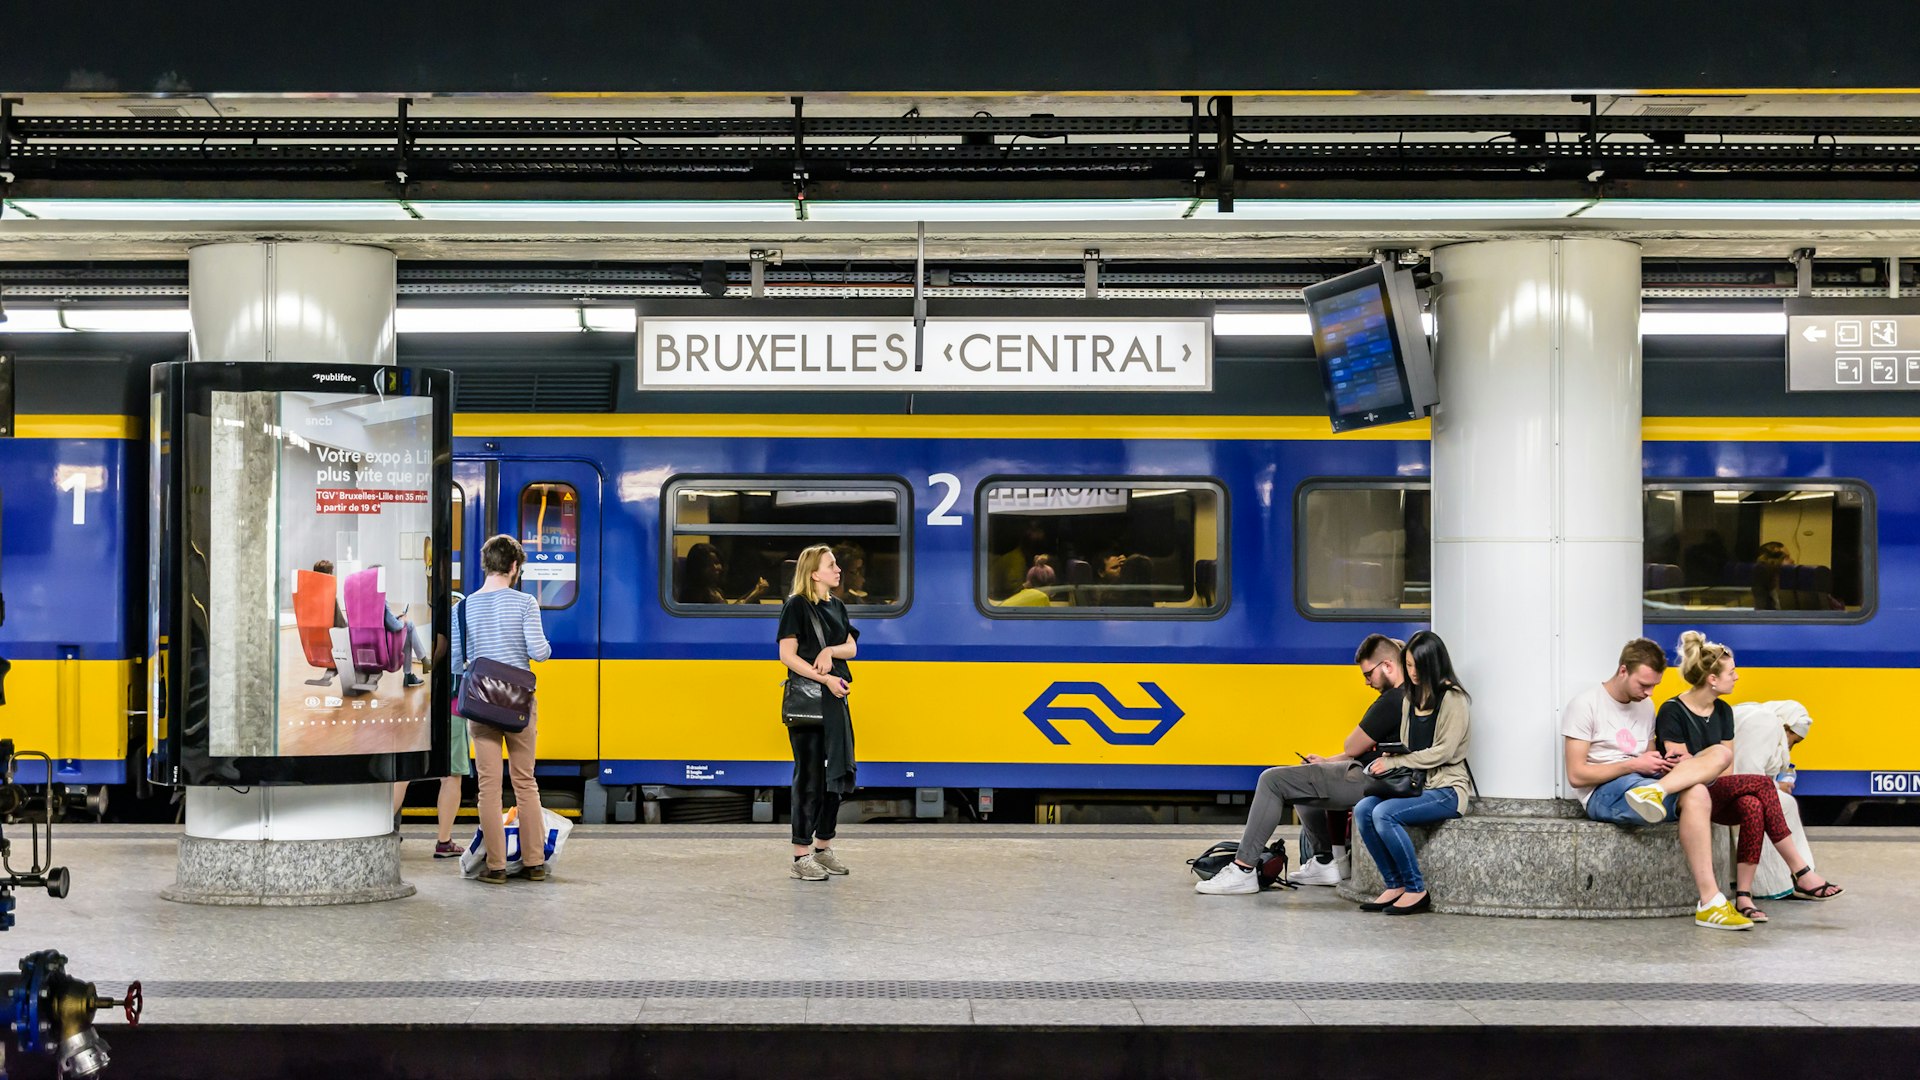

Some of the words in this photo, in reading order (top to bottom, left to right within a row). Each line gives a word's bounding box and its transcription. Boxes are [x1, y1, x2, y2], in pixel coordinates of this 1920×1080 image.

[655, 333, 908, 372] BRUXELLES
[320, 373, 352, 383] publifer
[1851, 366, 1858, 380] 1
[1884, 366, 1894, 380] 2
[316, 446, 361, 463] Votre
[365, 452, 400, 467] expo
[404, 449, 412, 464] à
[316, 466, 351, 485] plus
[354, 466, 383, 482] vite
[387, 471, 412, 486] que
[60, 472, 87, 525] 1
[339, 491, 393, 501] Bruxelles-Lille
[405, 493, 415, 501] 35
[926, 472, 963, 526] 2
[316, 503, 322, 512] à
[323, 503, 347, 513] partir
[348, 503, 360, 512] de
[361, 503, 370, 512] 19
[1874, 774, 1907, 791] 160
